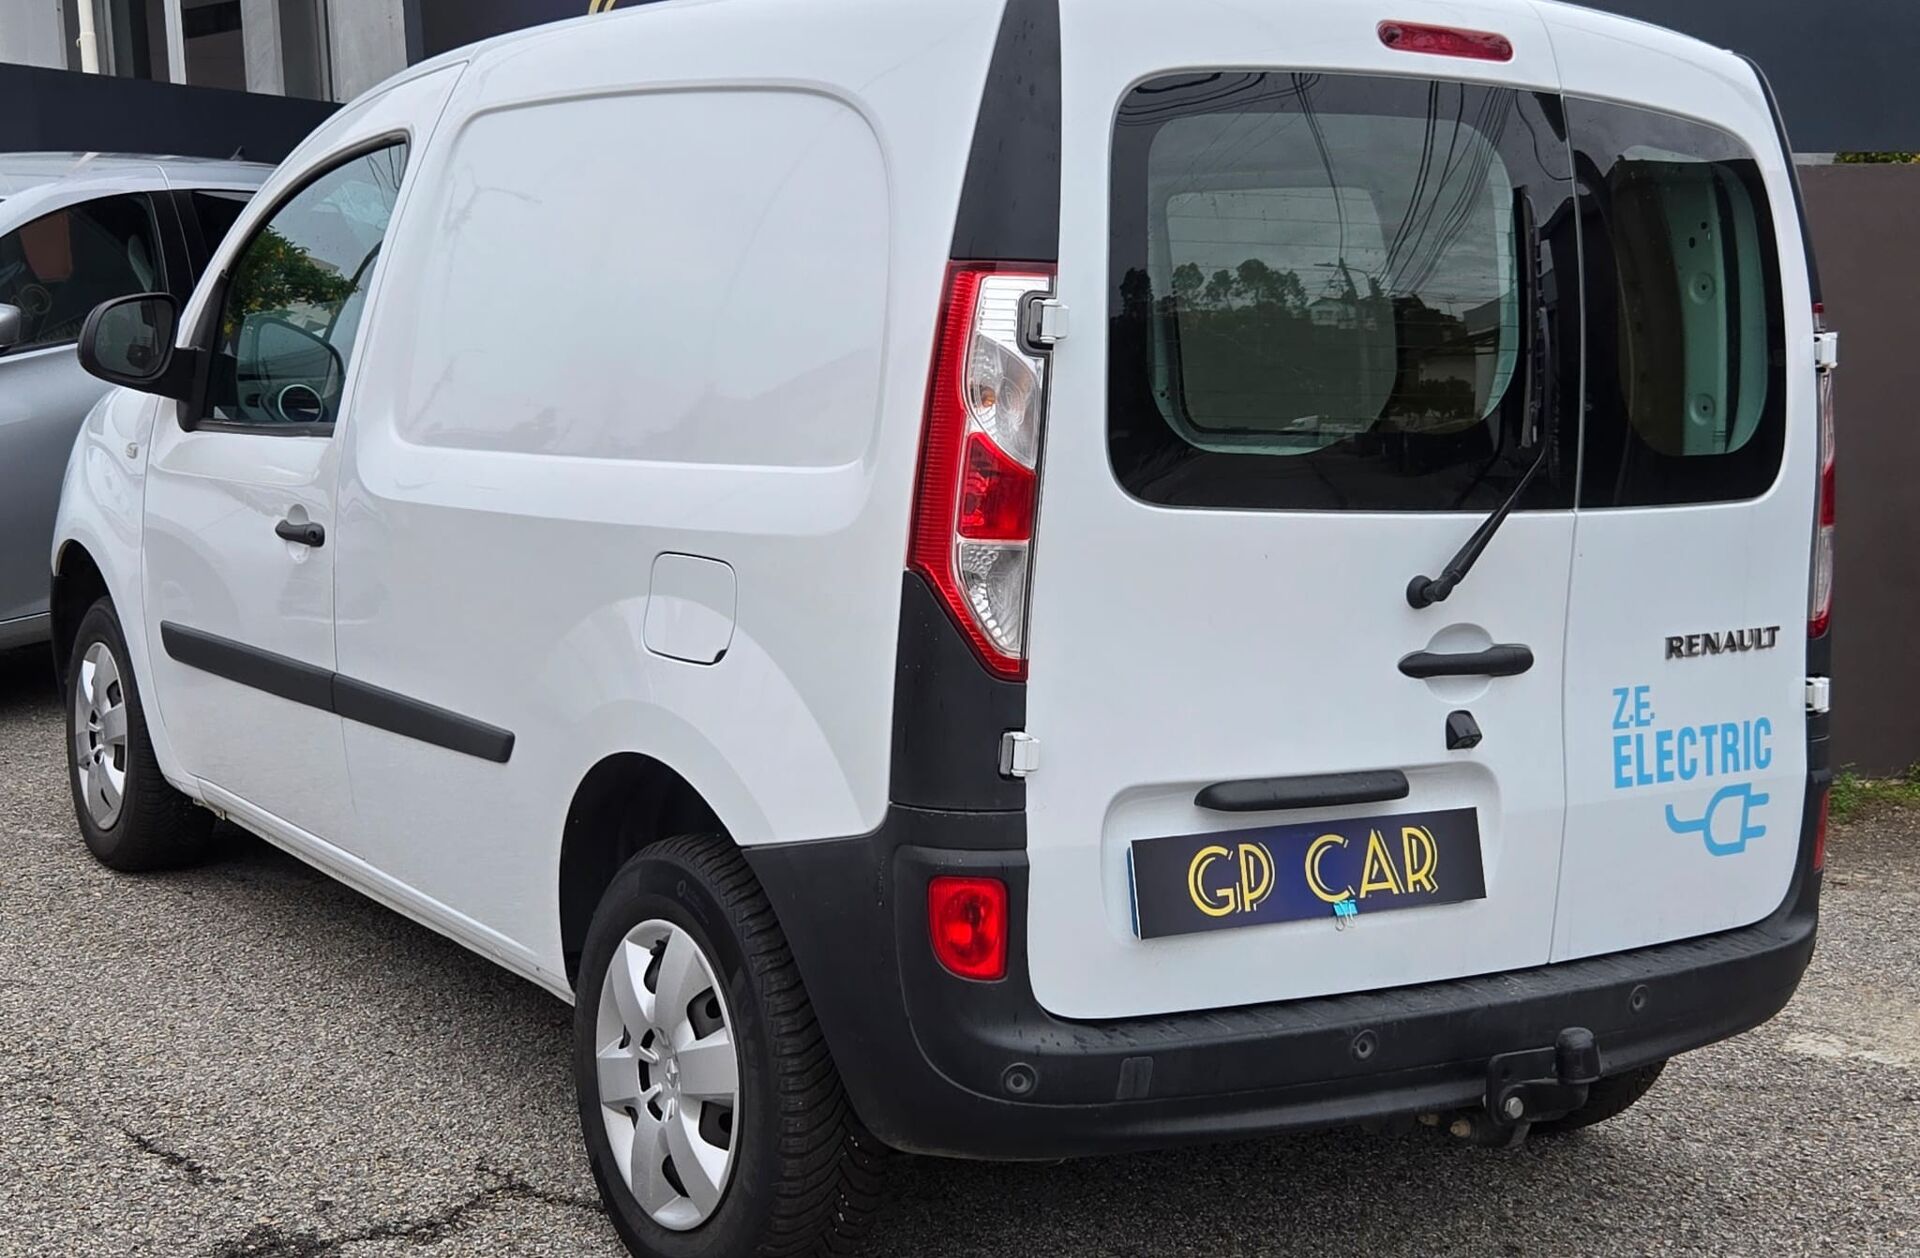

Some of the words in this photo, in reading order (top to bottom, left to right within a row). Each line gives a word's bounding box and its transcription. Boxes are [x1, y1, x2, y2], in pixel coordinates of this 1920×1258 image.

[1665, 625, 1780, 660] RENAULT
[1612, 685, 1655, 730] Z.E.
[1612, 716, 1773, 789] ELECTRIC
[1187, 842, 1276, 917] GP
[1304, 825, 1439, 904] CAR
